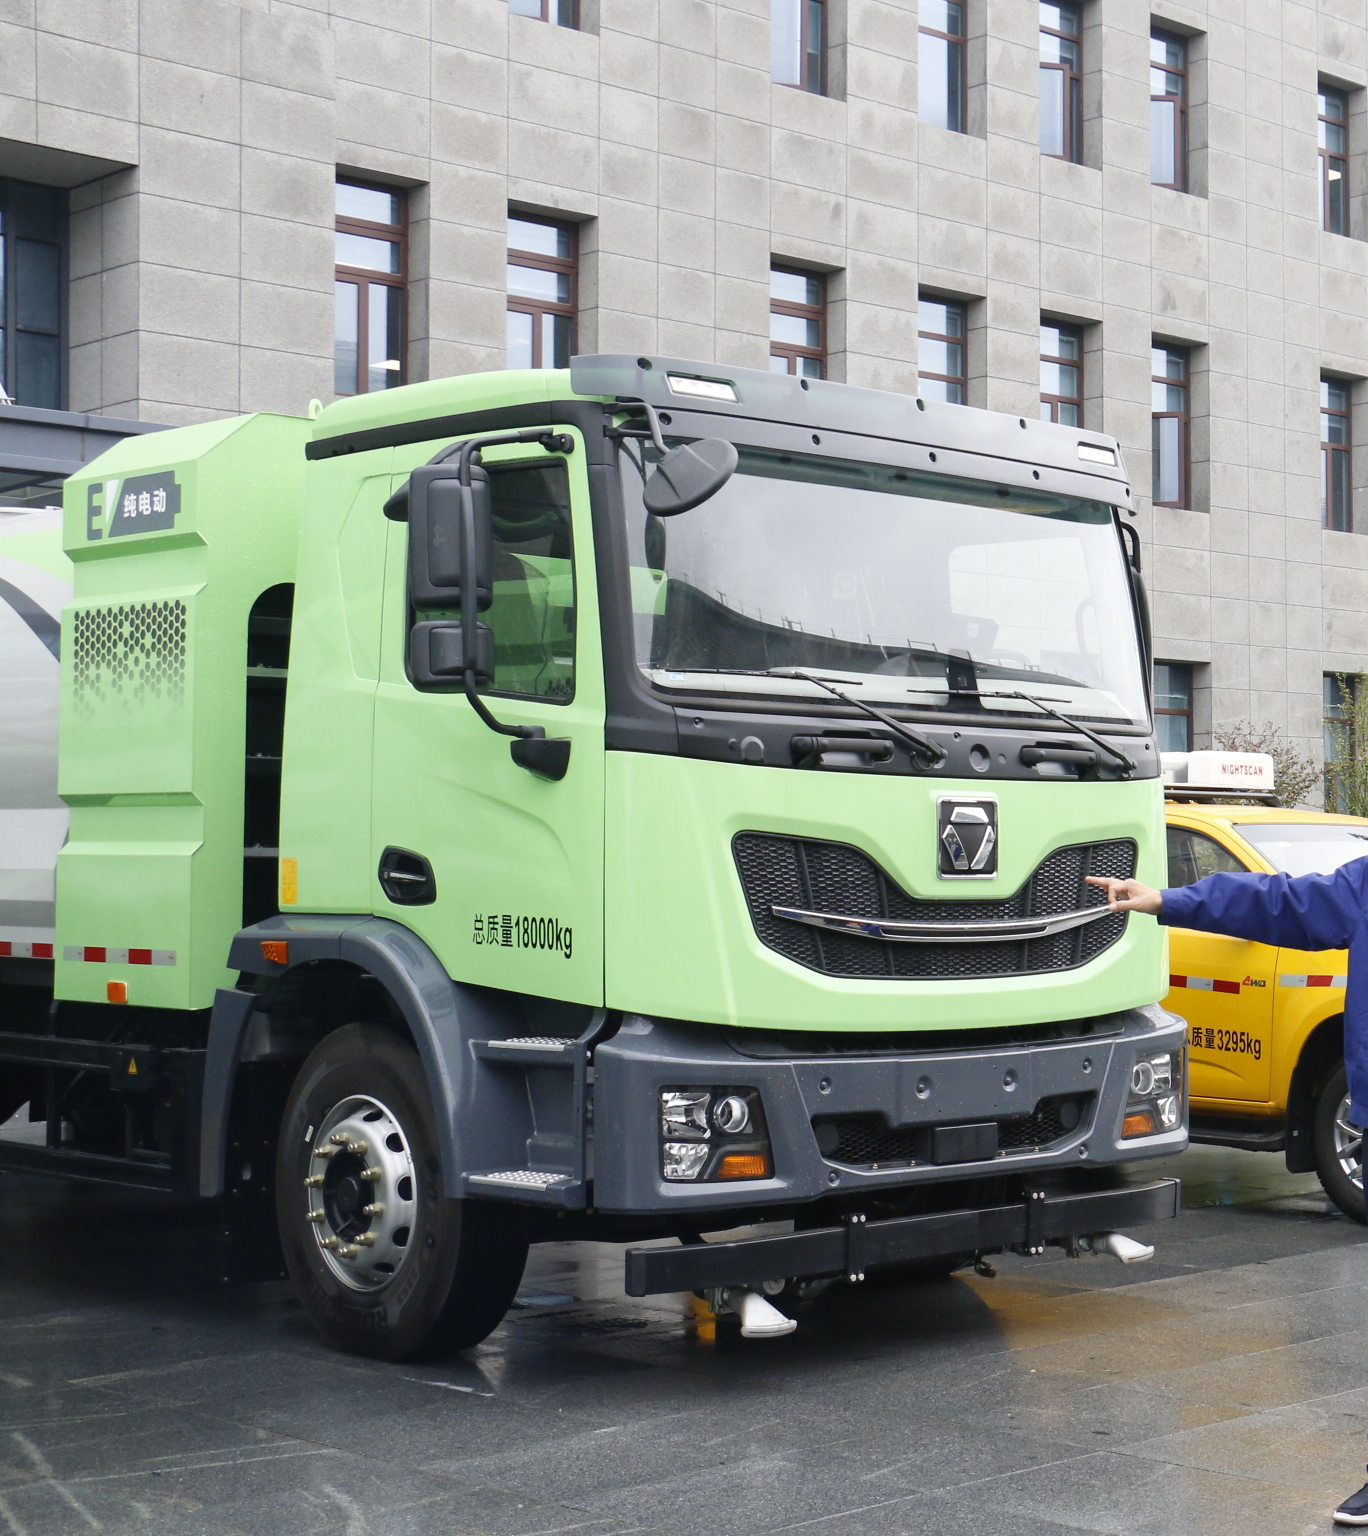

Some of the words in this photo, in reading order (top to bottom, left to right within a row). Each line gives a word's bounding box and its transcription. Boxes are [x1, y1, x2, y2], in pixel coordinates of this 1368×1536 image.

[123, 488, 167, 518] 纯电动
[1221, 764, 1263, 776] NIGHTSCAN
[472, 913, 573, 959] 总质量18000kg
[1187, 1026, 1262, 1060] 质量3295kg
